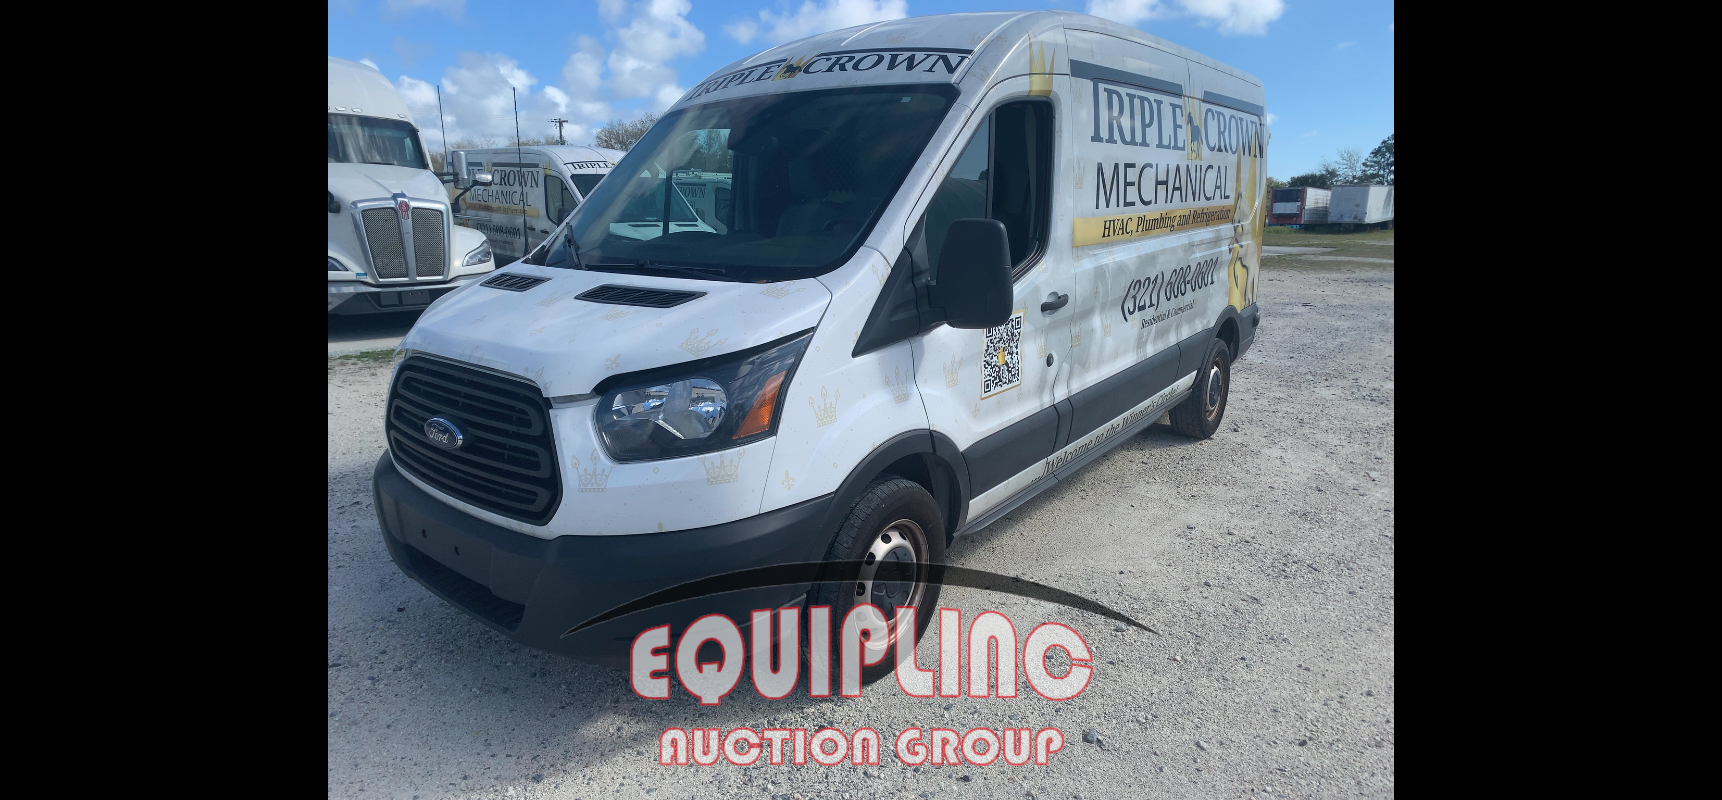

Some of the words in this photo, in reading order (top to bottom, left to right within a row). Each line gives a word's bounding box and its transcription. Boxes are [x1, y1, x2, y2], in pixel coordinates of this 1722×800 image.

[684, 63, 782, 102] TRIPLE
[801, 53, 968, 75] CROWN
[1090, 78, 1186, 151] TRIPLE
[1203, 107, 1265, 159] CROWN
[491, 168, 540, 188] CROWN
[572, 161, 613, 170] TRIPLE
[469, 188, 532, 207] MECHANICAL
[1095, 162, 1231, 209] MECHANICAL
[1102, 217, 1134, 238] HVAC,
[1135, 212, 1178, 232] Plumbing
[1177, 209, 1192, 227] and
[1191, 206, 1231, 226] Refrigeration
[1121, 270, 1165, 322] (321)
[1164, 256, 1219, 301] 608-0601
[429, 422, 450, 444] Ford
[1093, 432, 1104, 446] to
[1104, 423, 1120, 438] the
